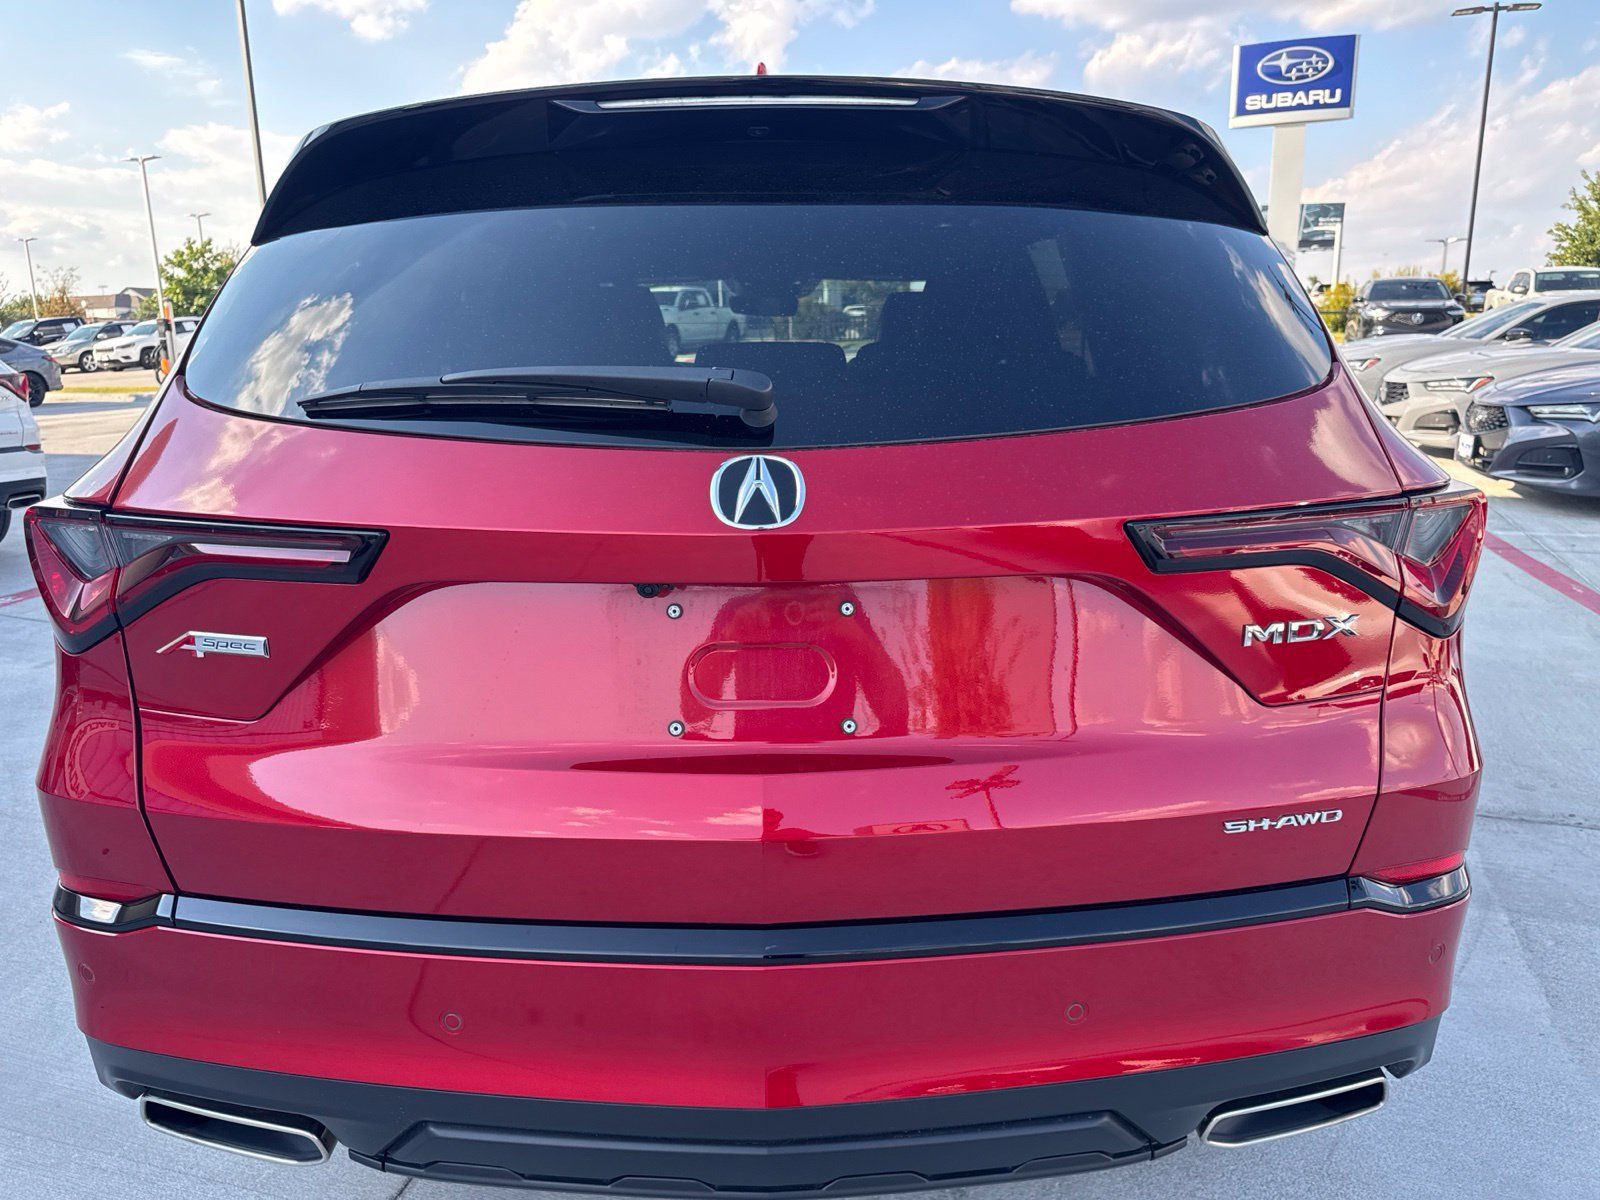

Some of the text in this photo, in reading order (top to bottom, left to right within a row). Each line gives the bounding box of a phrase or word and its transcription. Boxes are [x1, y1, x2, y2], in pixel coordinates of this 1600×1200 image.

[1245, 88, 1342, 111] SUBARU
[1242, 614, 1360, 648] MDX
[1223, 808, 1343, 834] SH-AWD
